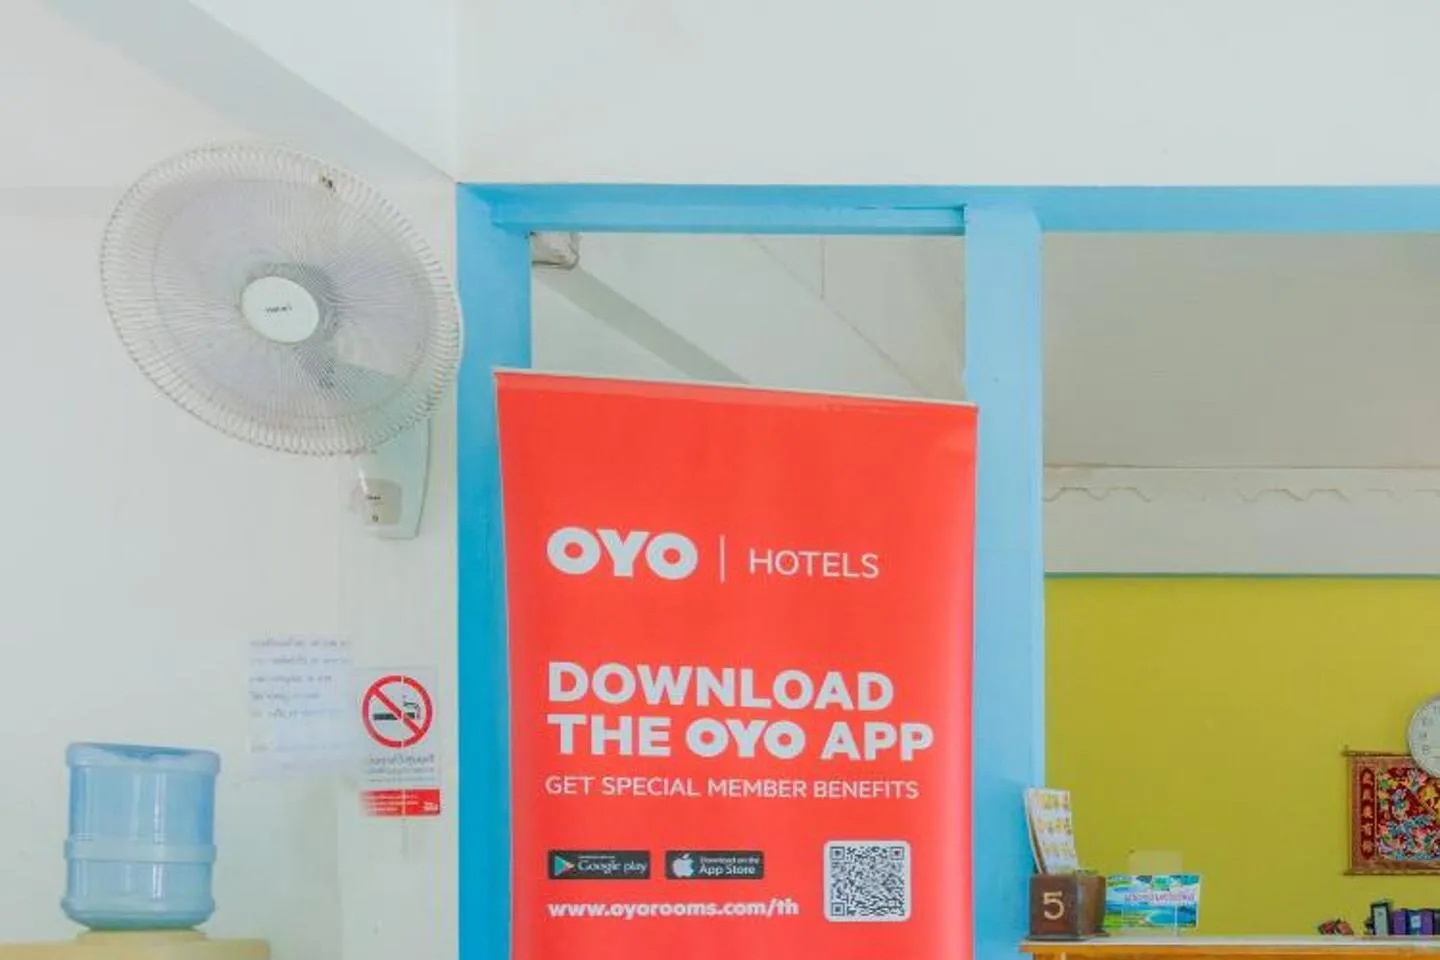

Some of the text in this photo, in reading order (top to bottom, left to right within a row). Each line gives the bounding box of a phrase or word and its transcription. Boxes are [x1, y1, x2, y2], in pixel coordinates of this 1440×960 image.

[546, 526, 880, 581] OYO HOTELS
[547, 661, 894, 711] DOWNLOAD
[547, 713, 935, 761] THE OYO APP
[545, 775, 920, 799] GET SPECIAL MEMBER BENEFITS
[576, 860, 648, 875] Google play
[699, 863, 756, 876] App Store
[547, 897, 800, 921] www.oyorooms.com/th
[1042, 890, 1066, 921] 5
